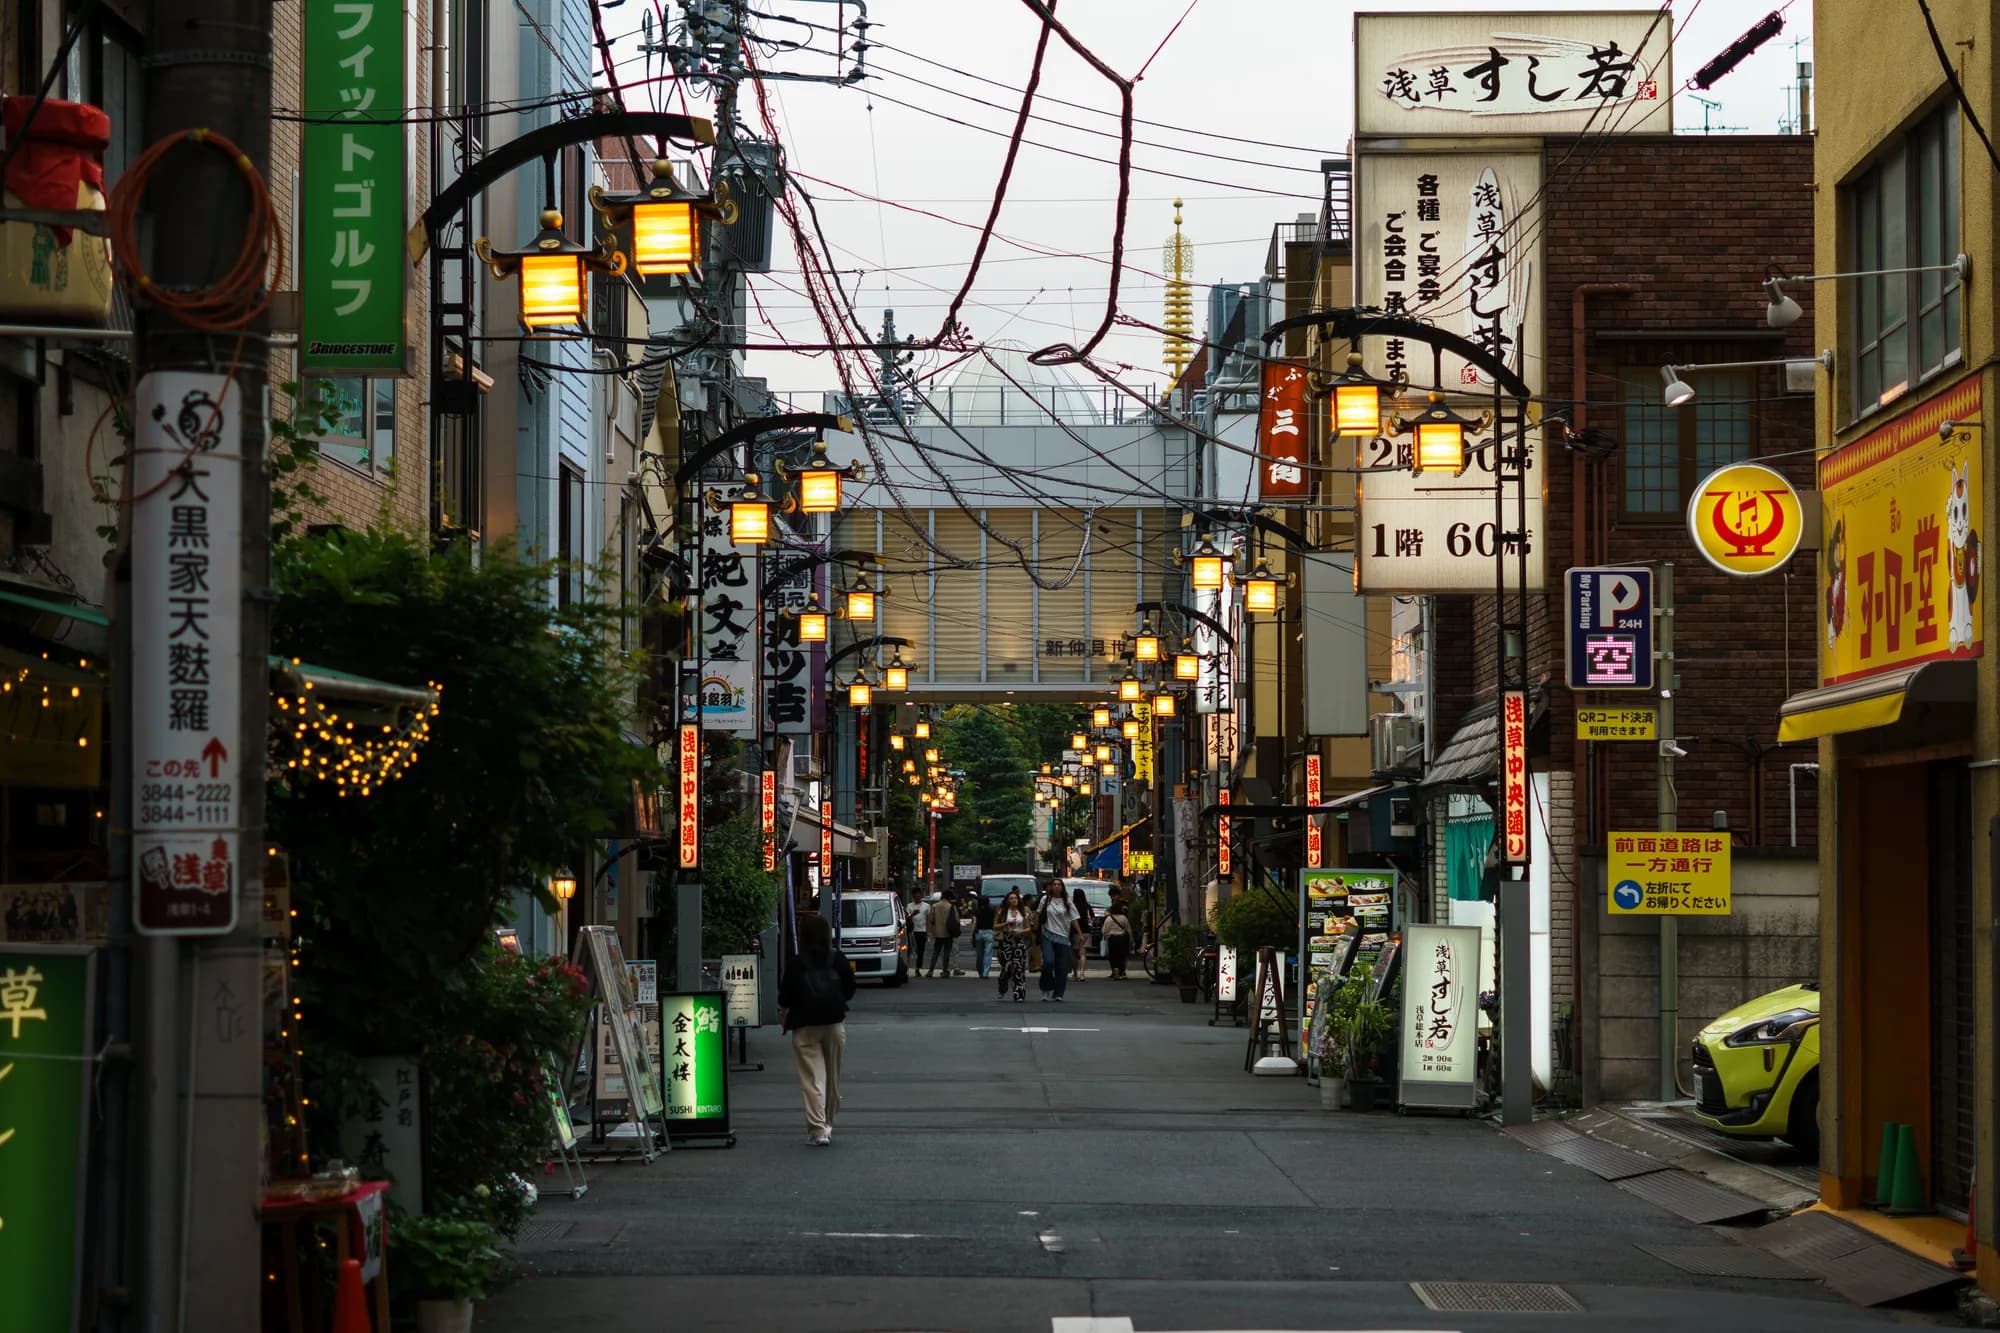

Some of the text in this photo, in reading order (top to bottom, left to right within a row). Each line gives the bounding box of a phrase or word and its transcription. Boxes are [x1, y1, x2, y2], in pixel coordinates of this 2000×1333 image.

[1384, 41, 1635, 102] 浅草すし若
[331, 3, 375, 316] フィットゴルフ
[1417, 174, 1440, 301] 各種 ご宴会
[1384, 211, 1406, 383] ご会合 承ます
[309, 343, 396, 355] BRIDGESTONE
[1371, 523, 1424, 558] 1階
[168, 459, 210, 732] 大黒家天麩羅
[1579, 575, 1591, 629] My Parking
[1600, 575, 1641, 627] P
[1618, 619, 1643, 629] 24H
[1586, 636, 1633, 680] 空
[1578, 711, 1654, 724] QRコード決済
[1589, 725, 1648, 736] 利用できます
[146, 759, 200, 779] この先
[1506, 695, 1524, 857] 浅草中央通り
[141, 784, 231, 803] 3844-2222
[683, 730, 695, 864] 浅草中央通り
[141, 805, 229, 824] 3844-1111
[1615, 838, 1723, 853] 前面道路は
[1625, 858, 1713, 873] 一方通行
[1645, 882, 1692, 895] 左折にて
[1645, 896, 1727, 909] お帰りください
[1427, 944, 1453, 1040] 浅草すし若
[696, 1006, 719, 1033] 鮨
[672, 1012, 692, 1081] 金太楼
[669, 1105, 722, 1114] SUSHI KINTARO
